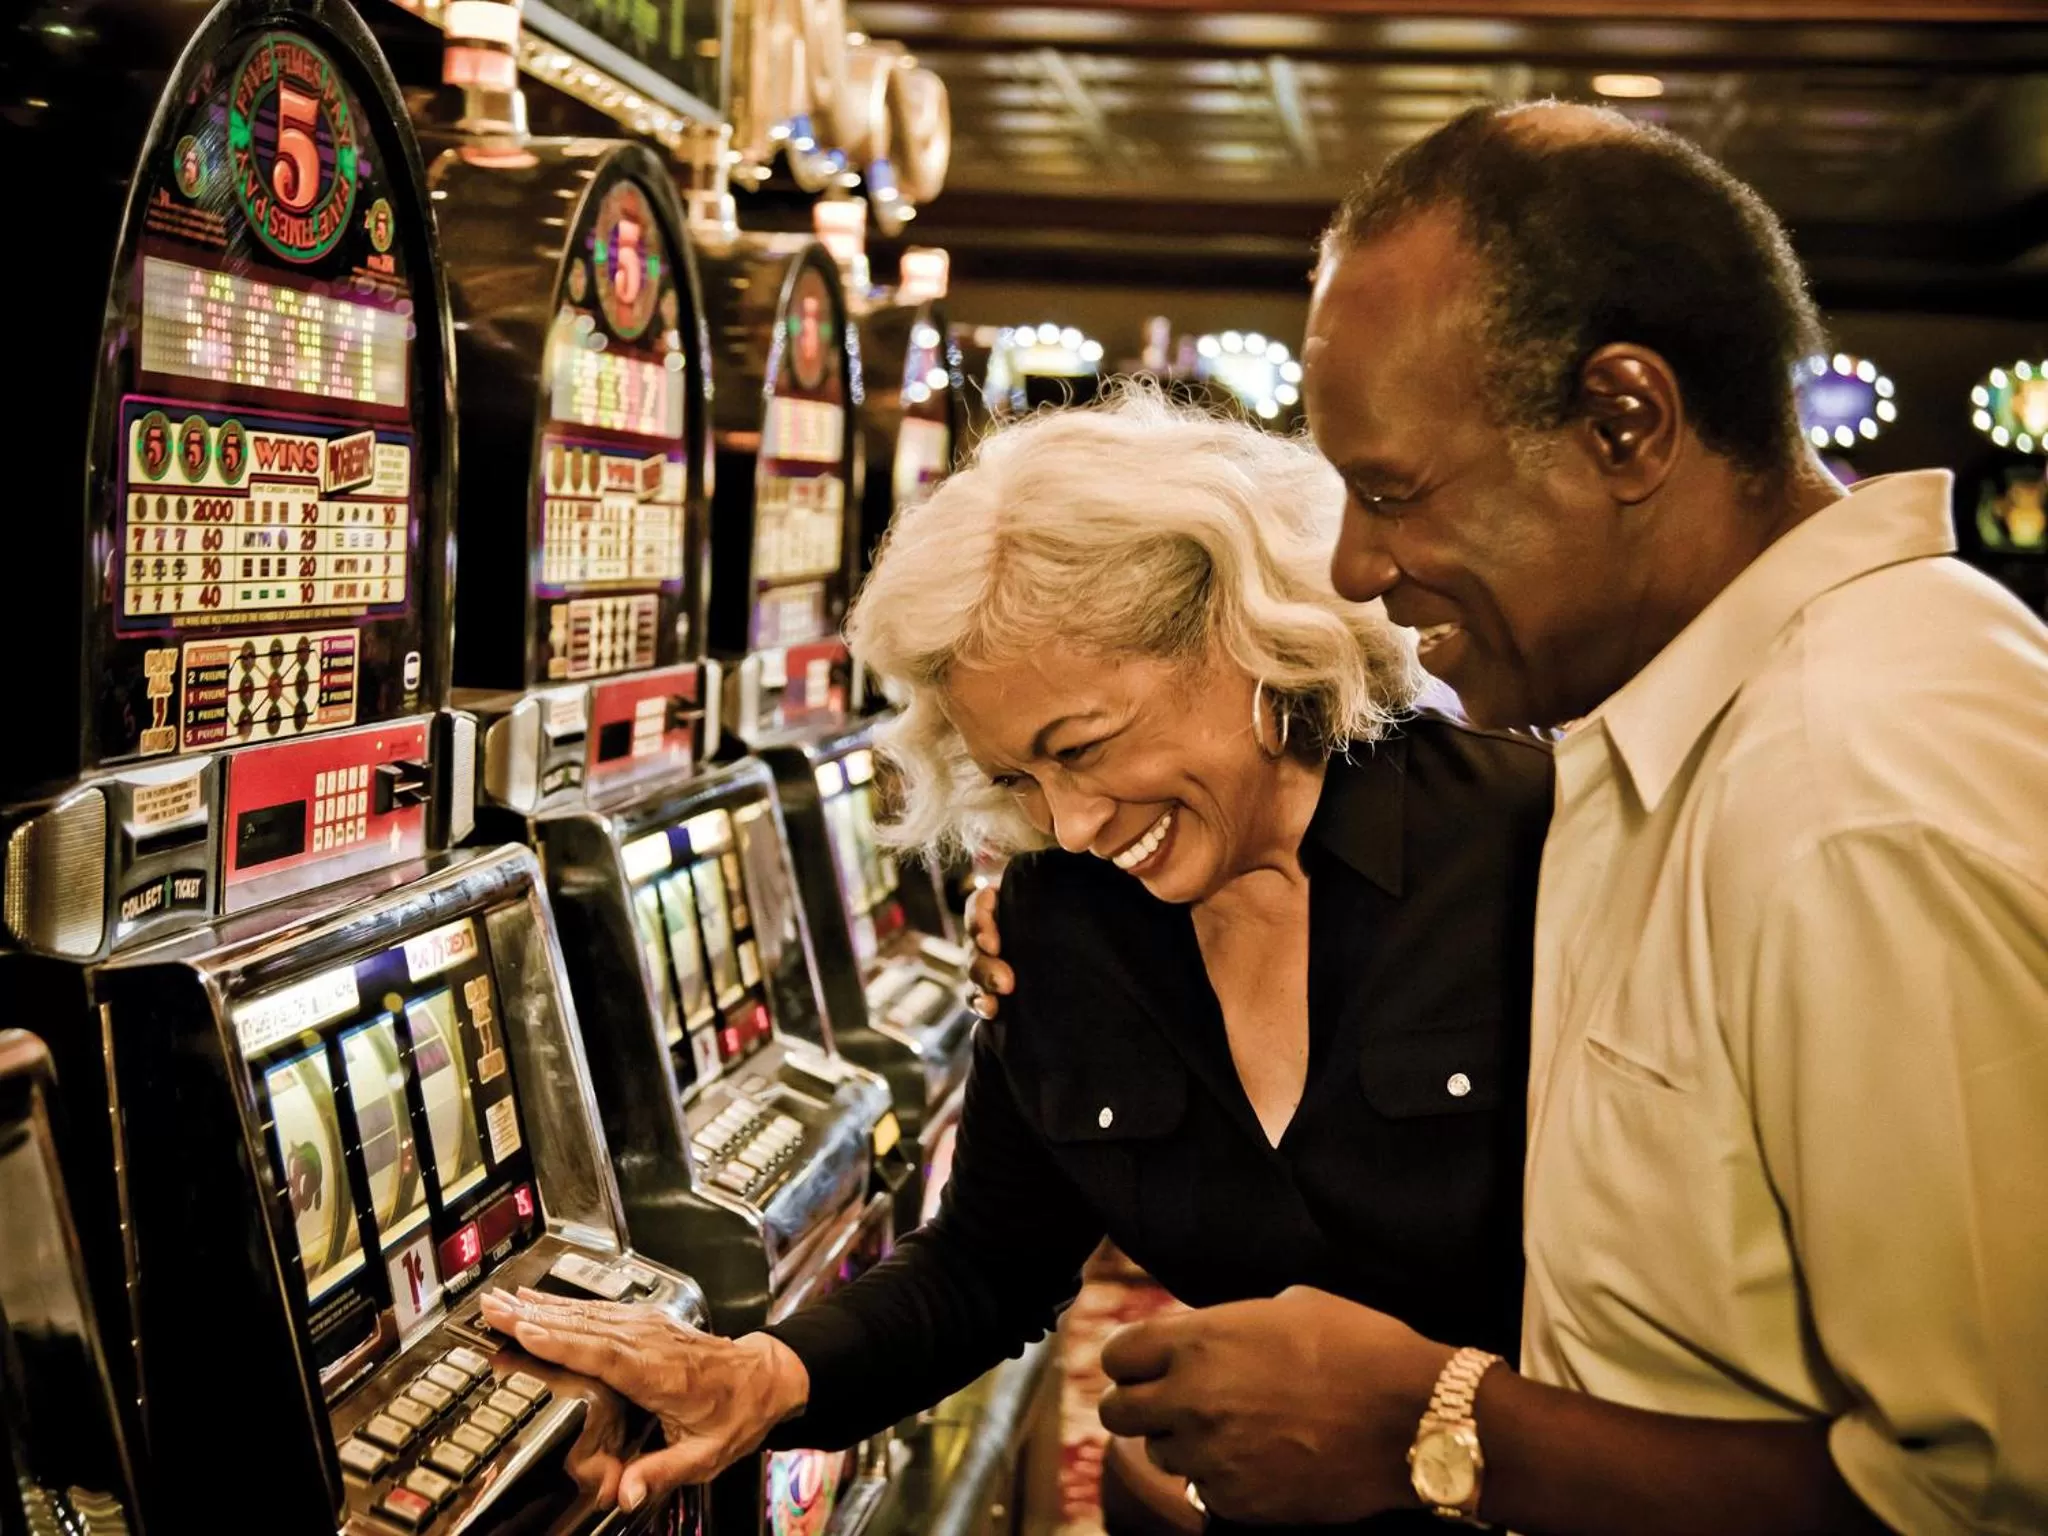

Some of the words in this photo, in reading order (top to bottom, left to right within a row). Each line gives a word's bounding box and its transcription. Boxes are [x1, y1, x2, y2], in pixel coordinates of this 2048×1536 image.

[272, 78, 321, 211] 5
[269, 205, 319, 249] TIMES
[253, 436, 319, 473] WINS
[193, 499, 233, 522] 2000
[134, 527, 146, 551] 7
[155, 527, 167, 551] 7
[175, 527, 187, 551] 7
[202, 528, 223, 551] 60
[299, 557, 317, 576] 20
[199, 585, 221, 608] 40
[300, 582, 315, 603] 10
[188, 671, 195, 684] 2
[187, 710, 194, 724] 3
[186, 730, 193, 743] 5
[121, 883, 163, 922] COLLECT
[174, 878, 201, 900] TICKET
